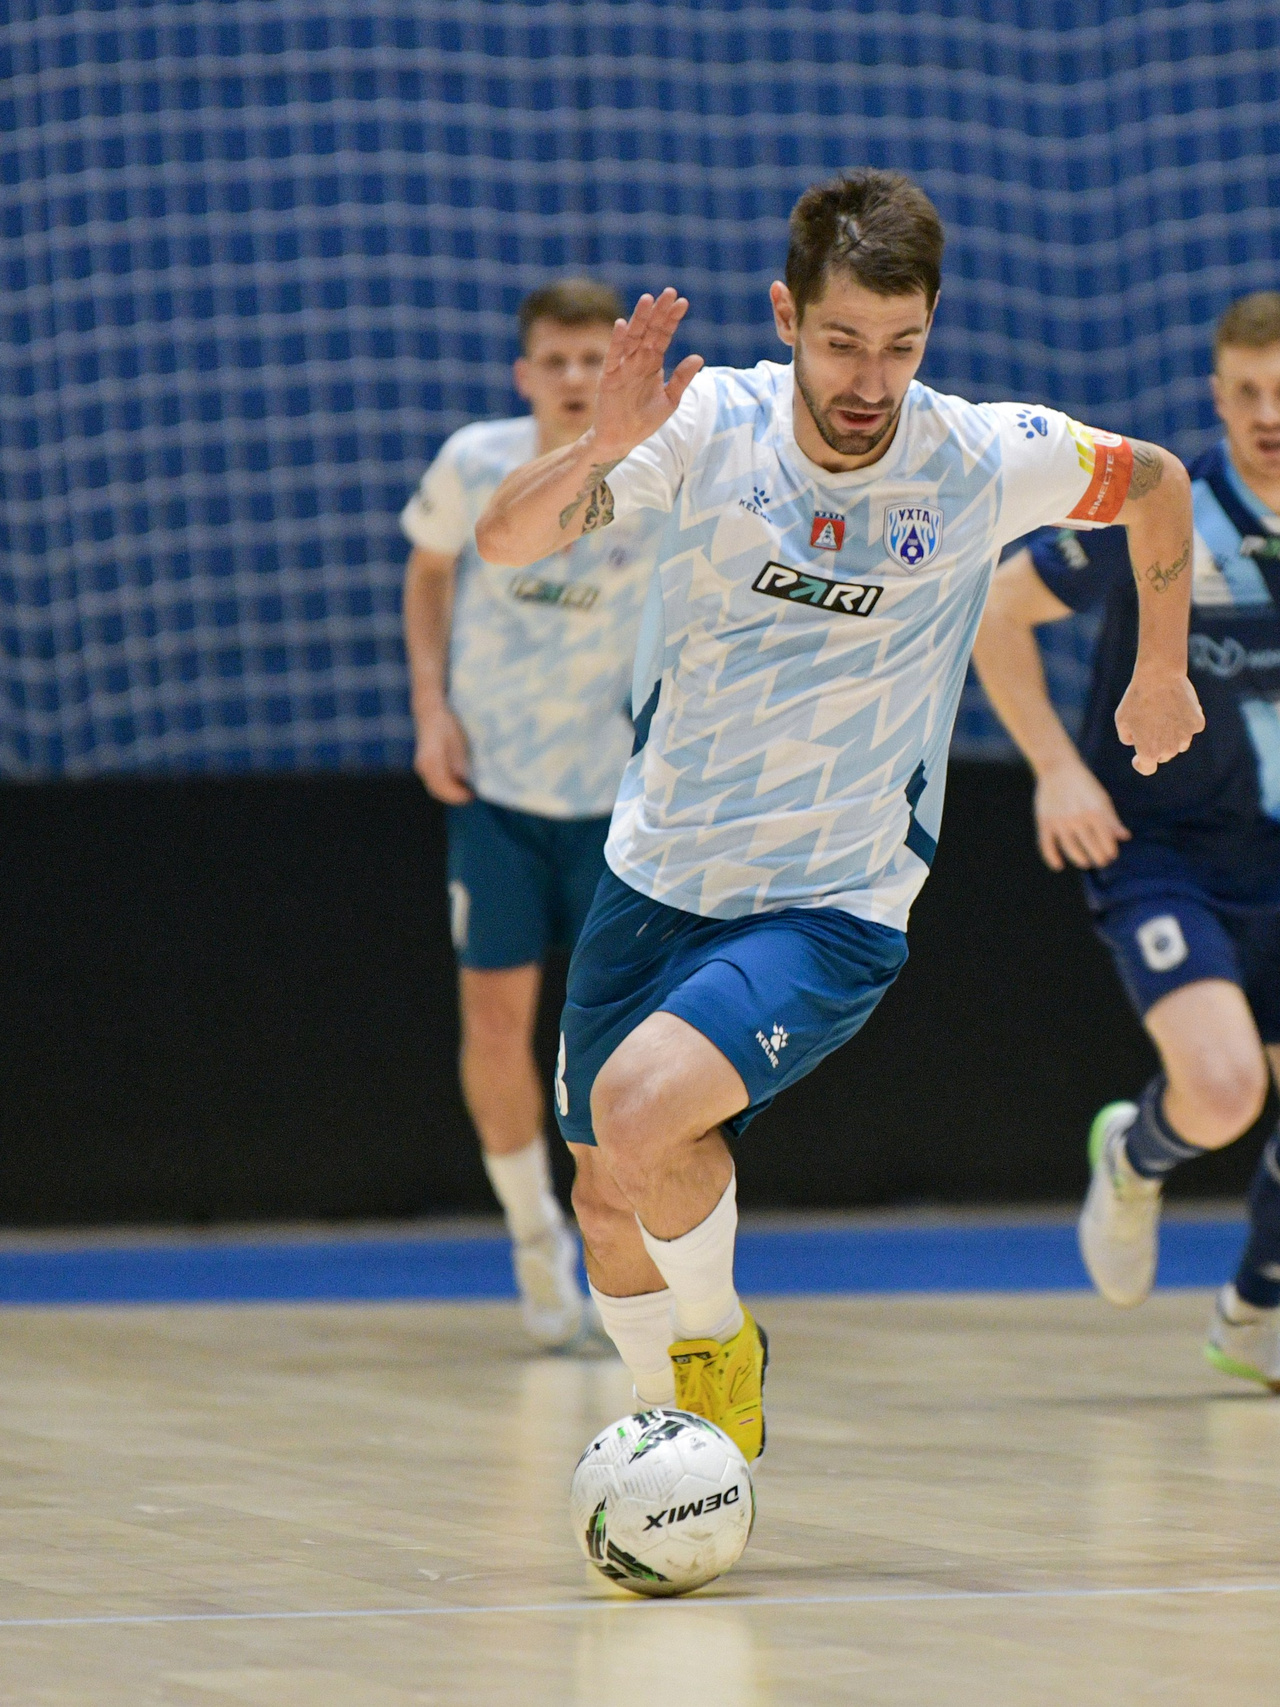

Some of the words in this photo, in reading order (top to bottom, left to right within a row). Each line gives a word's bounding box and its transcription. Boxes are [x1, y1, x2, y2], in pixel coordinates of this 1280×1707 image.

[899, 508, 930, 524] УХТА
[756, 564, 878, 614] PARI
[755, 1030, 780, 1069] KELME
[643, 1485, 740, 1532] DEMIX
